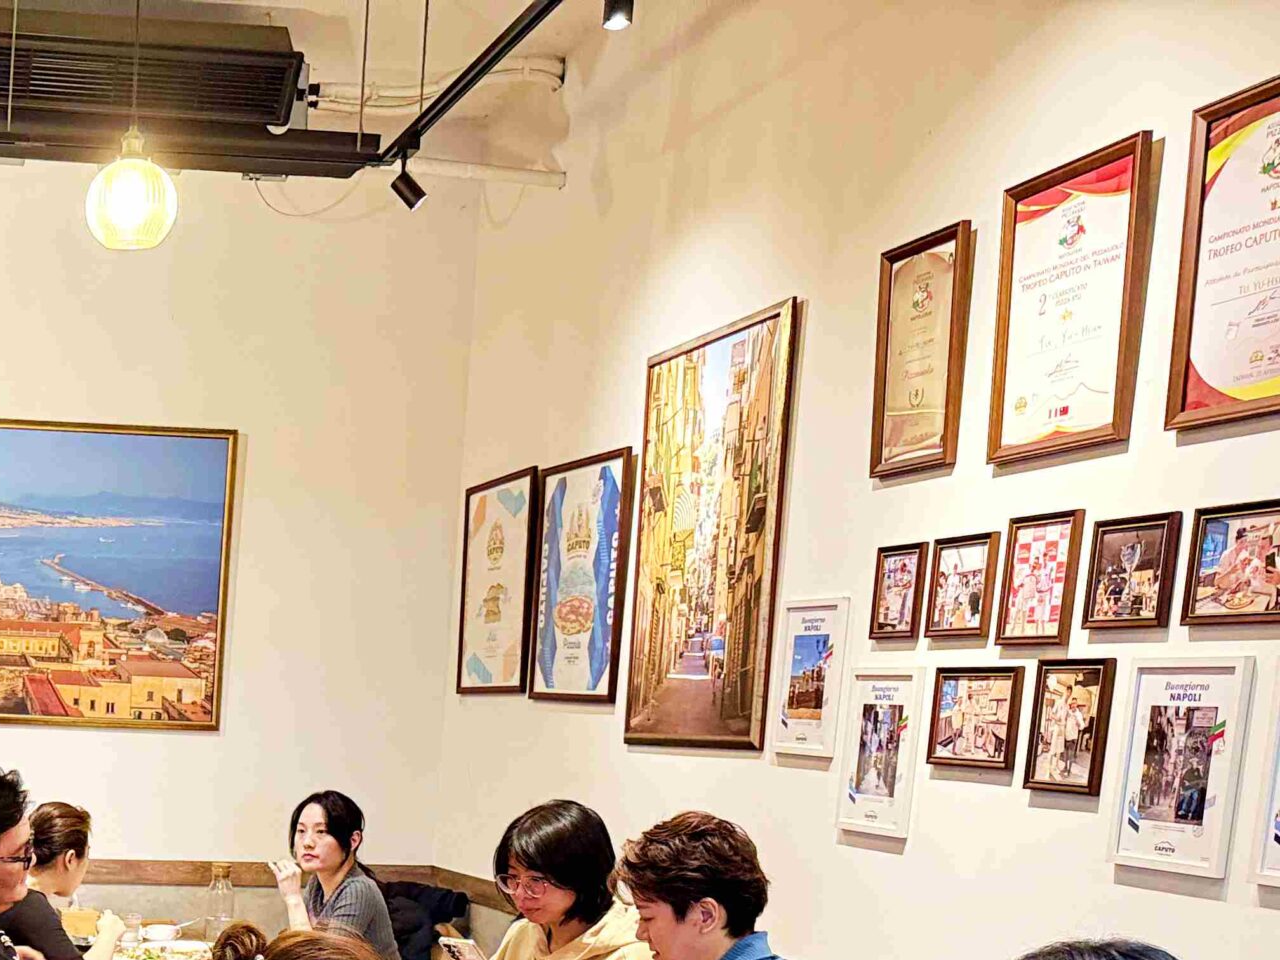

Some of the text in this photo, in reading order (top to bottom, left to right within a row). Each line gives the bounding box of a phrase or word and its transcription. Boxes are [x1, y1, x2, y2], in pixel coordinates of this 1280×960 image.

[1207, 241, 1243, 260] TROFEO
[1049, 264, 1082, 283] CAPUTO
[1094, 252, 1121, 269] TAIWAN
[566, 540, 591, 553] CAPUTO
[803, 624, 822, 632] NAPOLI
[871, 684, 899, 693] Buongiorno
[1164, 680, 1210, 693] Buongiorno
[874, 694, 895, 702] NAPOLI
[1169, 693, 1202, 703] NAPOLI
[1154, 845, 1176, 854] CAPUTO
